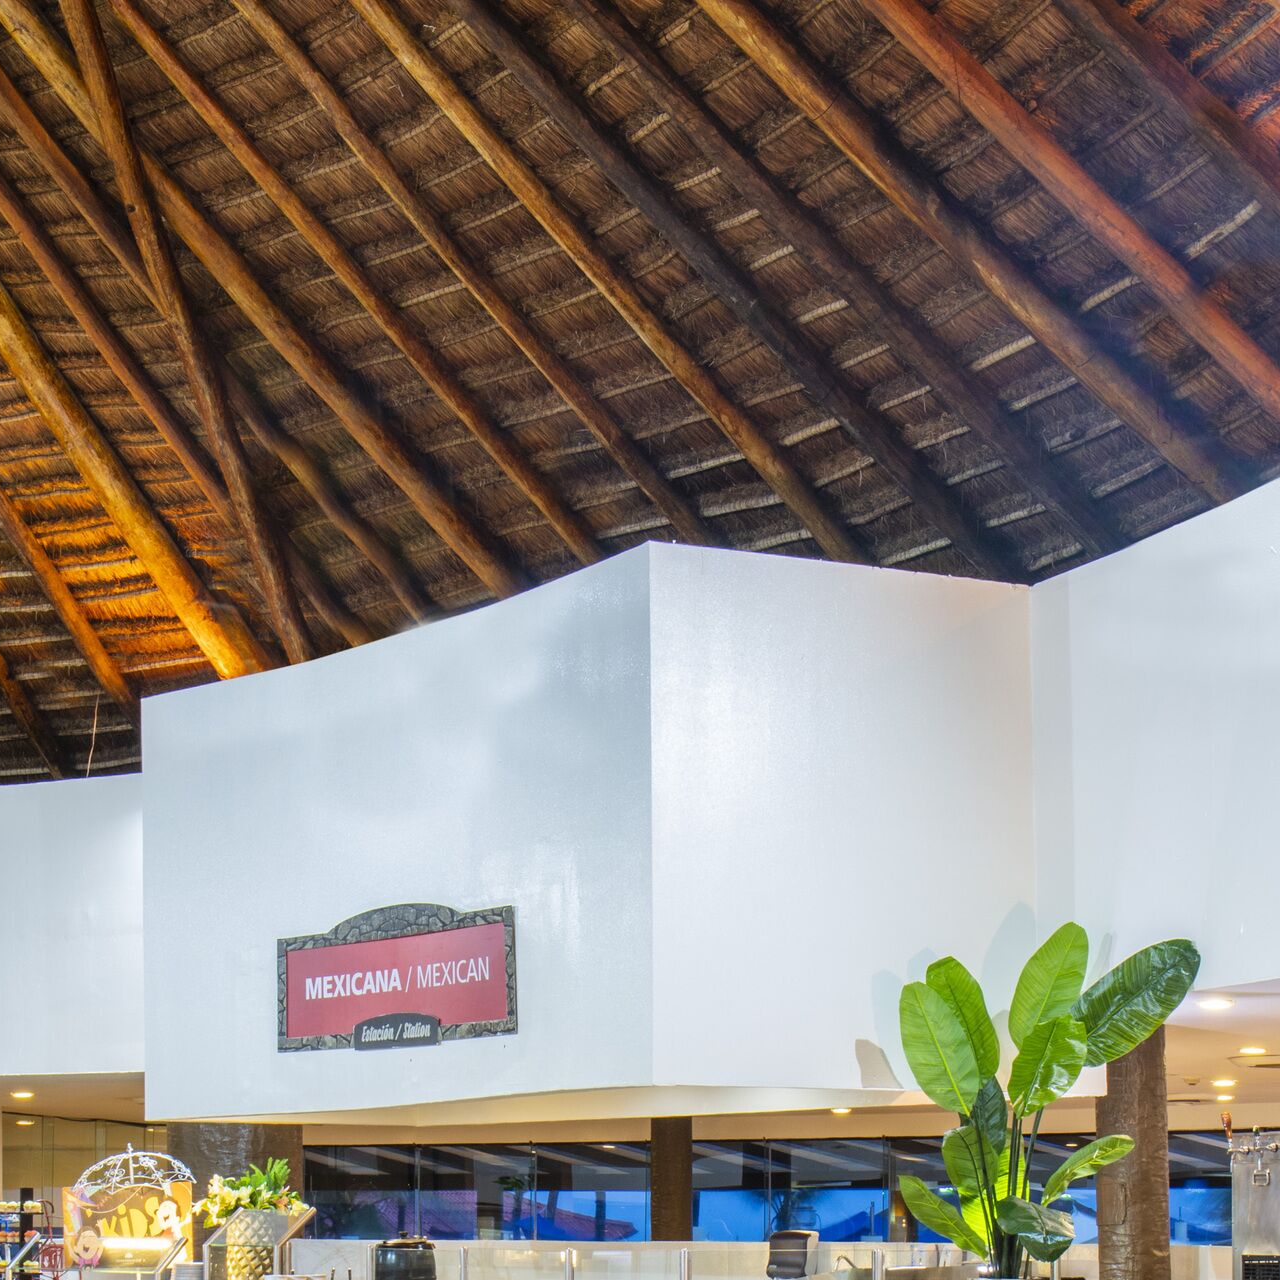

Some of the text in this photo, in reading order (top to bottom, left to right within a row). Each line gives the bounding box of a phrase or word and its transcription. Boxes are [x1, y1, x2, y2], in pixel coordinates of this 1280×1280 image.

[305, 956, 490, 1000] MEXICANA / MEXICAN
[361, 1021, 431, 1042] Estación / Station
